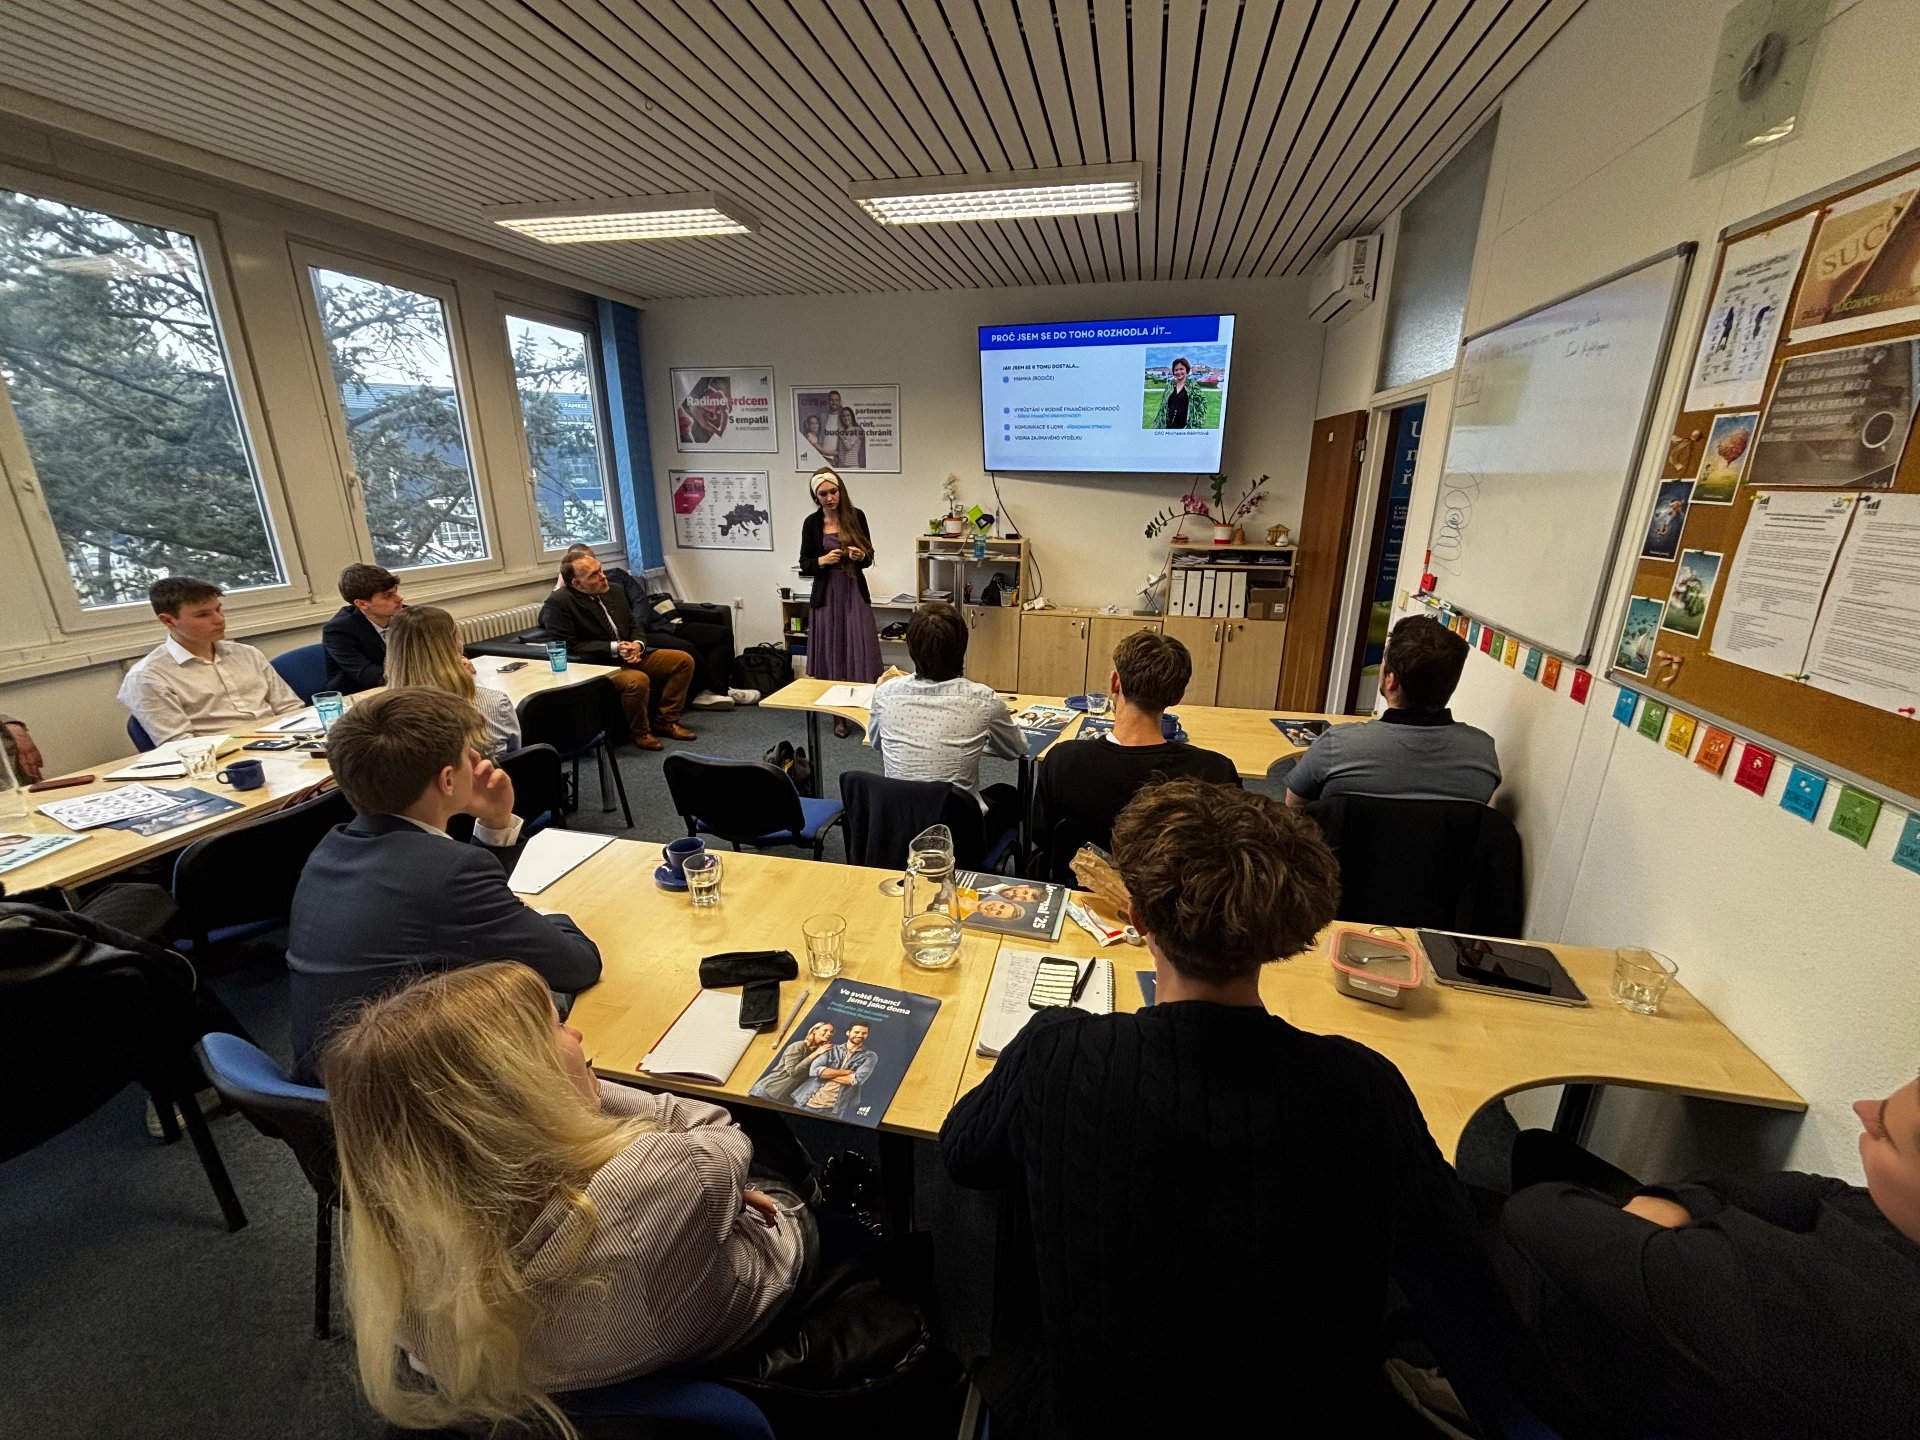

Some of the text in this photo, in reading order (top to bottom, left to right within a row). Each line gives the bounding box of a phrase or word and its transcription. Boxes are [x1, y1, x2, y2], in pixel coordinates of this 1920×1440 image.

[991, 332, 1015, 342] PROČ
[1017, 332, 1039, 341] JSEM
[1040, 332, 1052, 340] SE
[1053, 331, 1067, 340] DO
[1068, 330, 1095, 339] TOHO
[1097, 328, 1149, 338] ROZHODLA
[855, 407, 892, 415] partnerem
[728, 416, 734, 424] S
[824, 428, 857, 436] budovat
[1032, 915, 1050, 929] '25
[840, 988, 849, 996] Ve
[850, 991, 872, 1001] světě
[847, 996, 867, 1006] jsme
[867, 1001, 886, 1010] jako
[886, 1005, 911, 1015] doma
